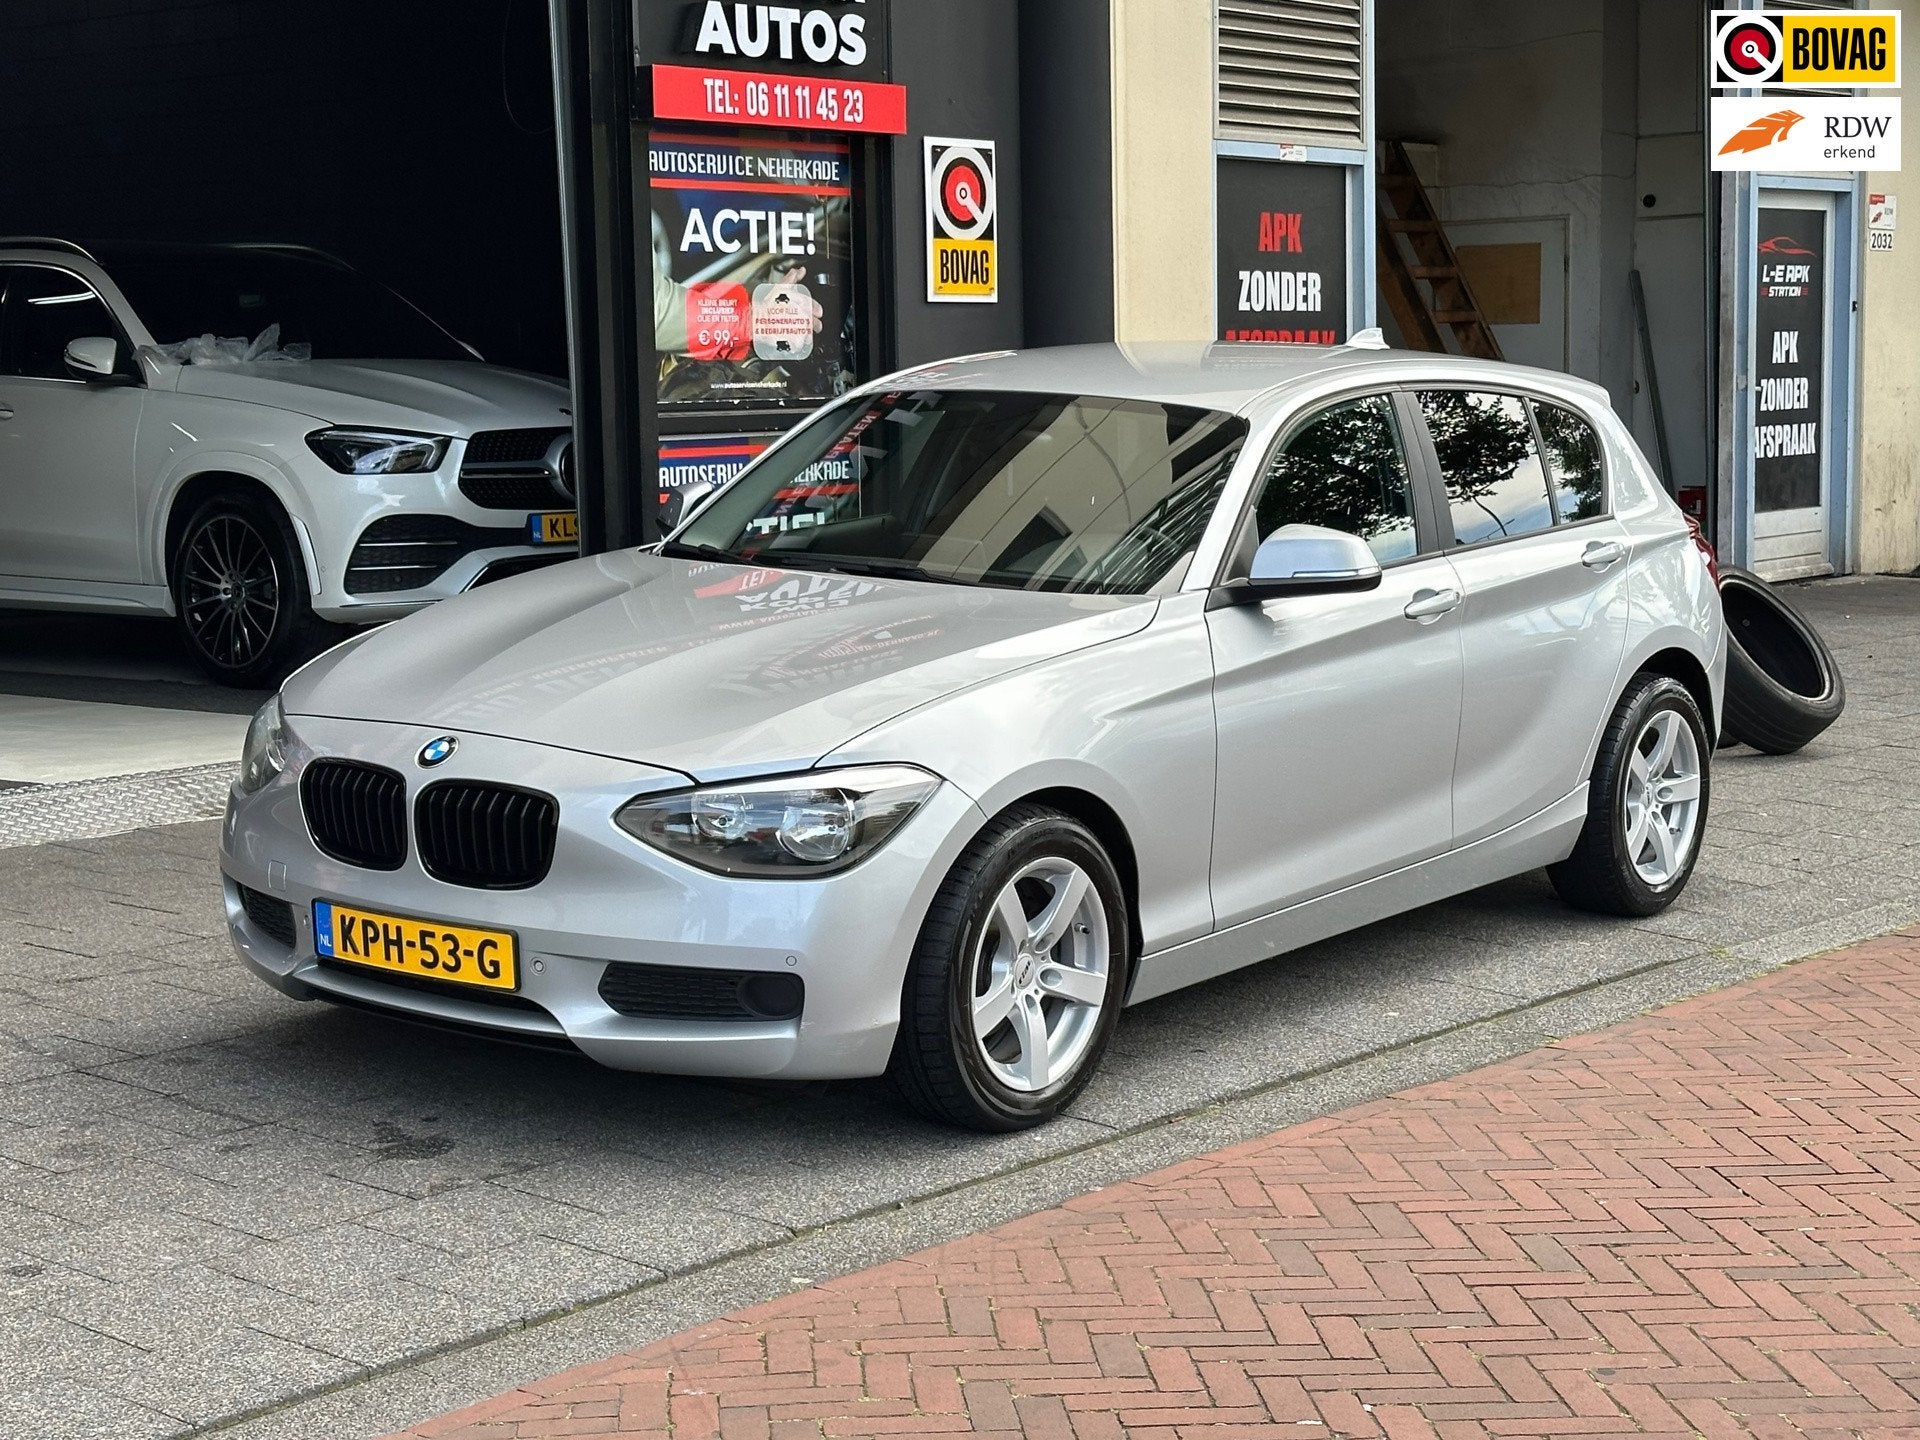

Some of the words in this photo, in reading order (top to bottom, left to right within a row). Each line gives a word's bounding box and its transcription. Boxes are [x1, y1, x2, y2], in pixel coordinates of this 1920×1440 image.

[695, 0, 867, 66] AUTOS
[703, 77, 740, 115] TEL:
[746, 80, 769, 117] 06
[773, 83, 790, 118] 11
[795, 85, 811, 119] 11
[816, 87, 838, 122] 45
[843, 88, 864, 124] 23
[649, 150, 754, 177] AUTOSERVICE
[757, 156, 840, 181] NEHERKADE
[679, 207, 816, 256] ACTIE!
[1258, 211, 1303, 253] APK
[1871, 233, 1893, 249] 2032
[940, 248, 990, 285] BOVAG
[1238, 270, 1322, 312] ZONDER
[1768, 285, 1802, 297] STATION
[1772, 331, 1799, 363] APK
[1760, 377, 1809, 411] ZONDER
[320, 933, 332, 947] NL
[339, 914, 501, 980] KPH-53-G
